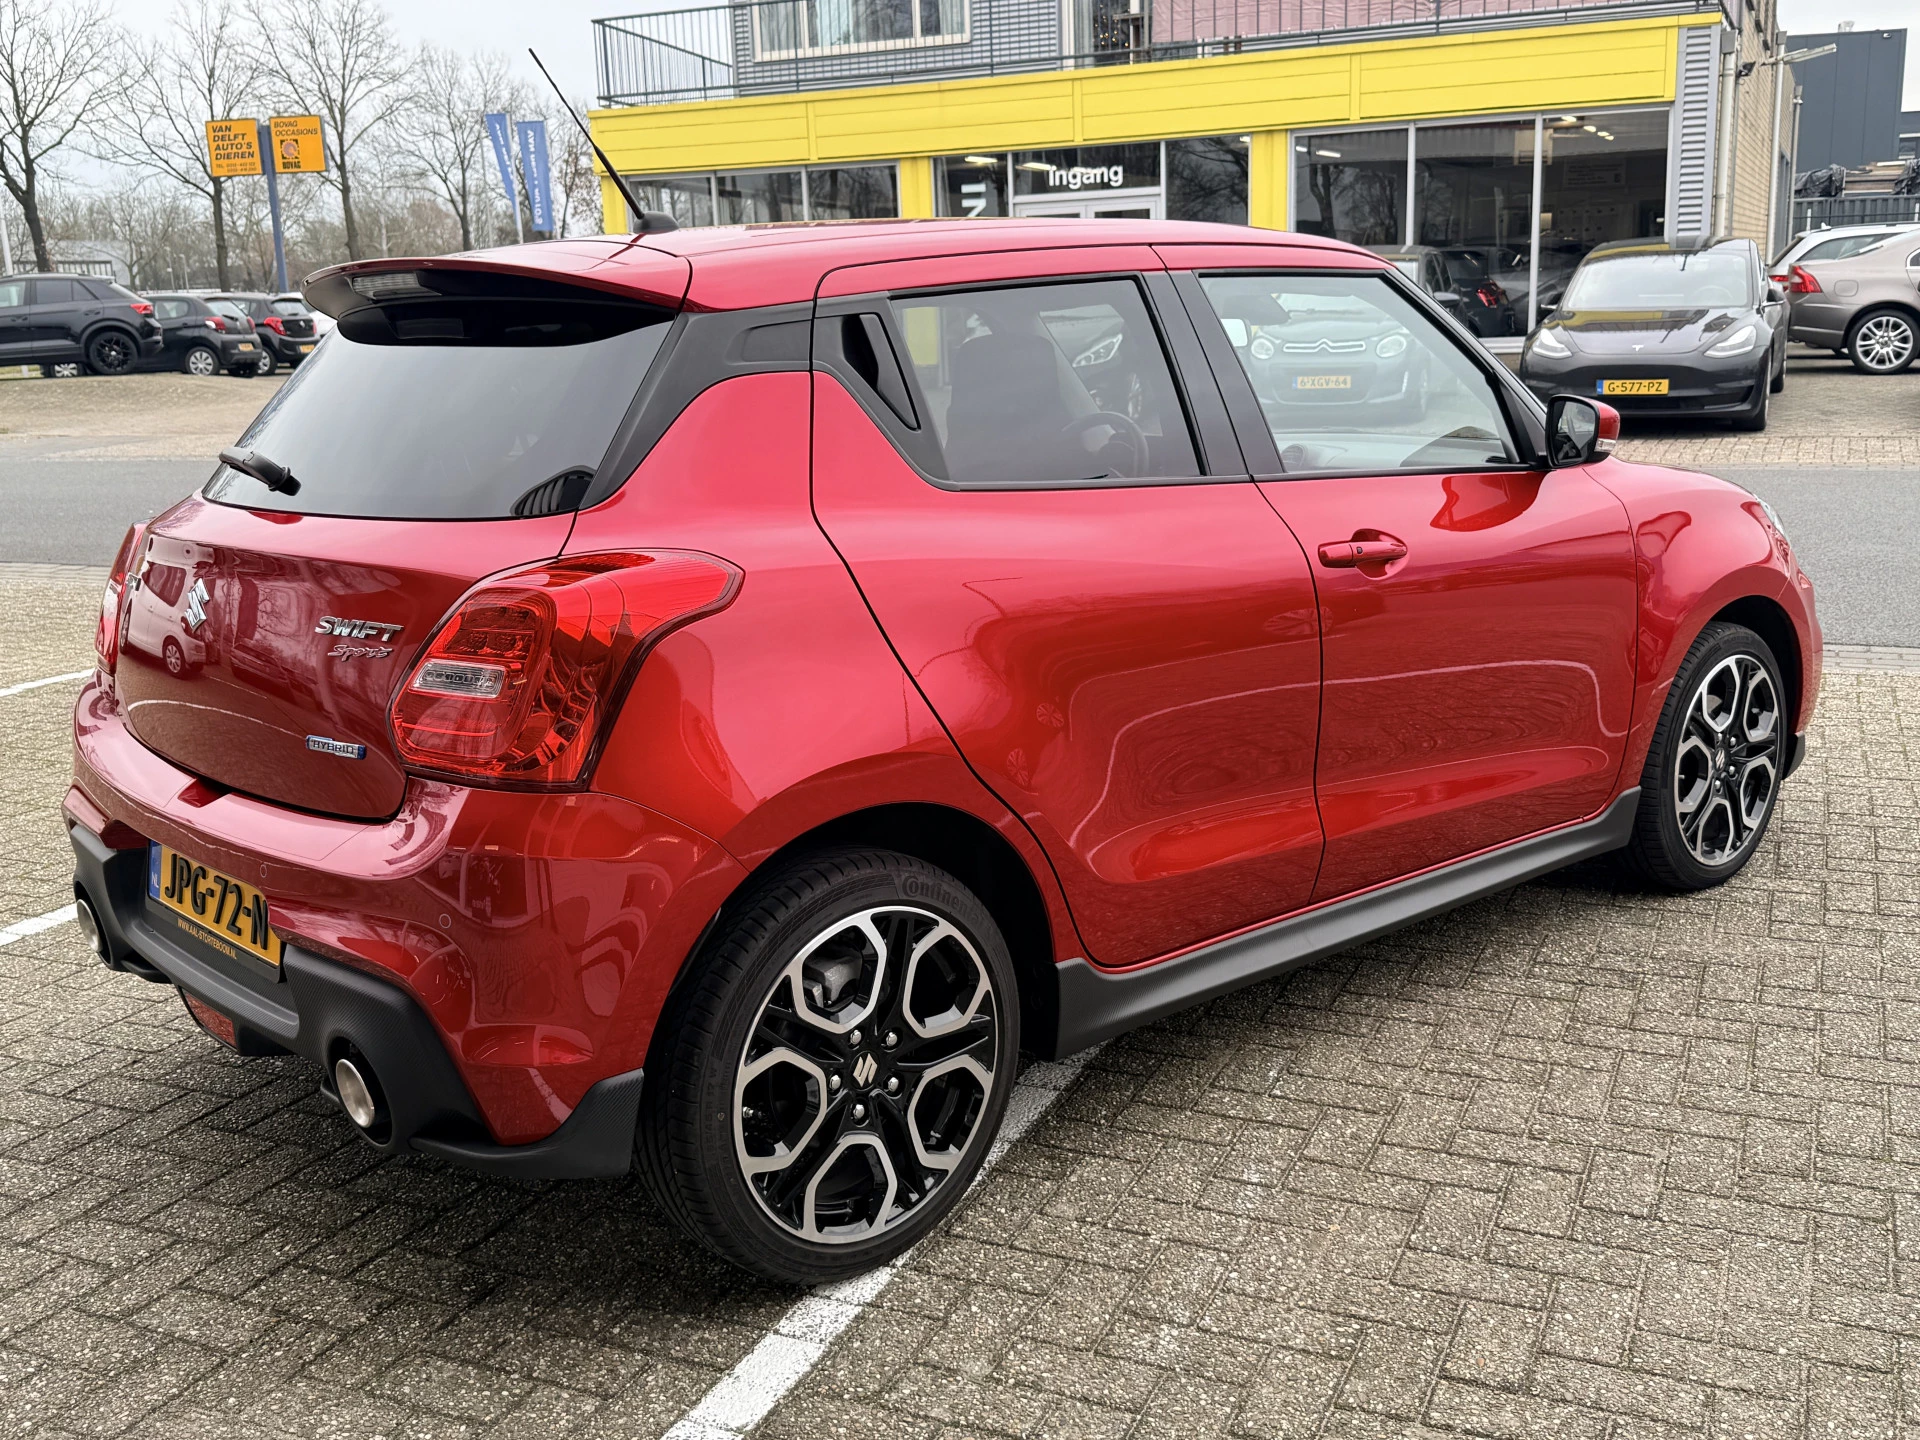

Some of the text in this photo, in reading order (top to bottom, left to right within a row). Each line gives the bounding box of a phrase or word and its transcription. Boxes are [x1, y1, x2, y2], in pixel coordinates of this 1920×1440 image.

[274, 120, 298, 128] BOVAG
[212, 125, 231, 133] VAN
[275, 128, 318, 136] OCCASIONS
[213, 133, 247, 142] DELFT
[215, 142, 253, 151] AUTO'S
[215, 151, 255, 160] DIEREN
[282, 161, 302, 169] BOVAG
[1300, 377, 1348, 387] 6-XGV-64
[1608, 382, 1662, 392] G-577-PZ
[315, 616, 404, 641] SWIFT
[312, 739, 355, 755] HYBRID
[151, 871, 160, 889] NL
[165, 853, 269, 950] JPG-72-N
